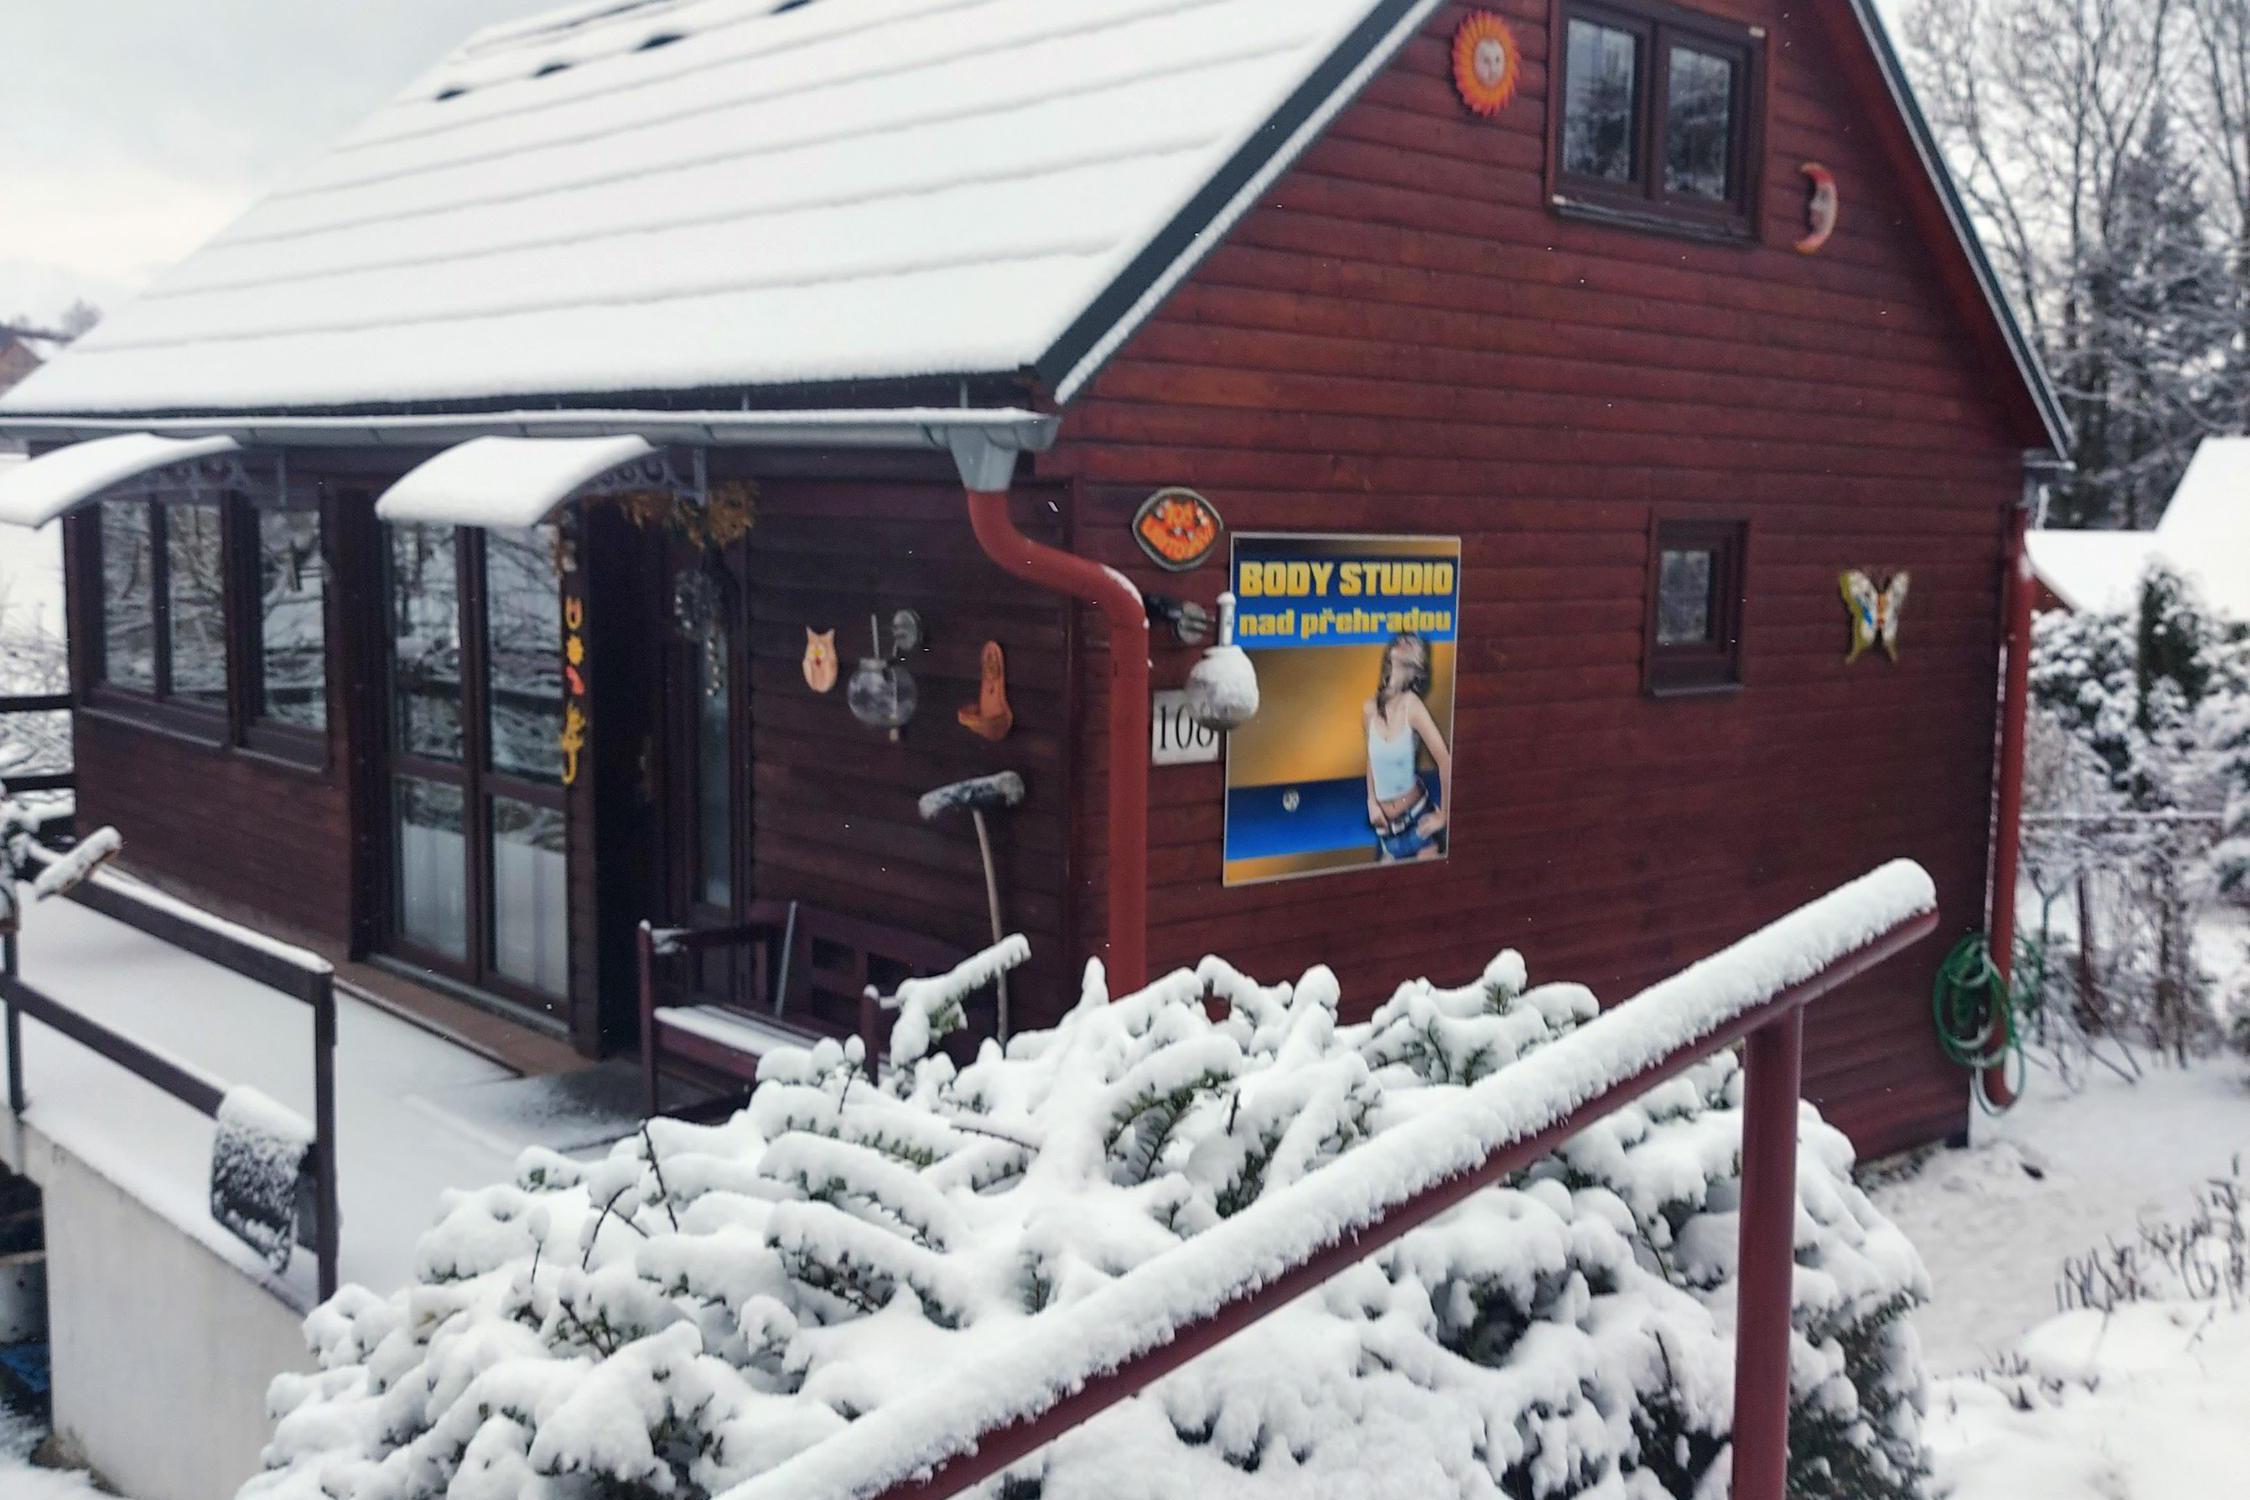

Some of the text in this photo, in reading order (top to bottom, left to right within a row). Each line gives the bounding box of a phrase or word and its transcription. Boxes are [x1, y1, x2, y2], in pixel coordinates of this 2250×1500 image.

[1239, 562, 1453, 597] BODY STUDIO
[1239, 607, 1451, 640] nad přehradou
